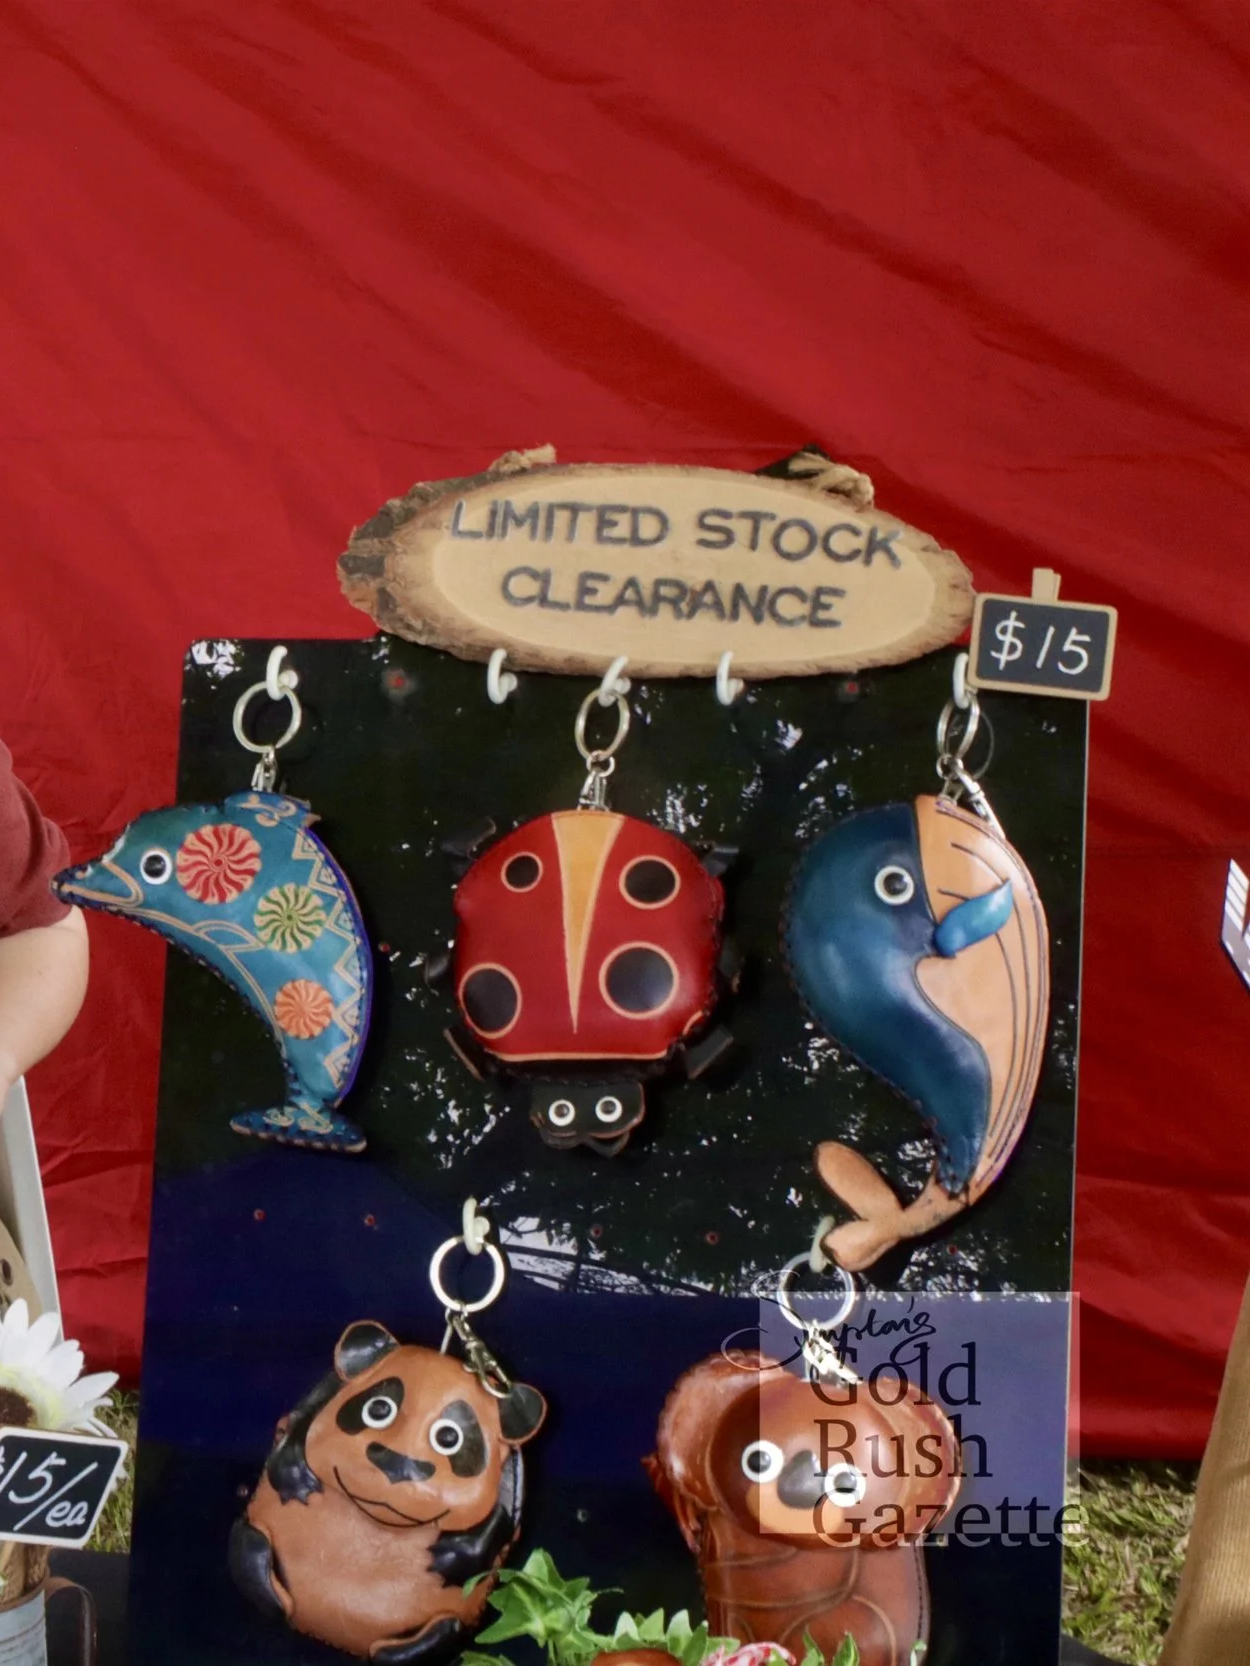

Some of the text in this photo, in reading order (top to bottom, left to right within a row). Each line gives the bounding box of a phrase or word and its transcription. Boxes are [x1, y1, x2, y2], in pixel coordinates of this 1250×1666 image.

[450, 500, 903, 569] LIMITED STOCK
[500, 564, 847, 628] CLEARANCE
[989, 609, 1094, 676] $15
